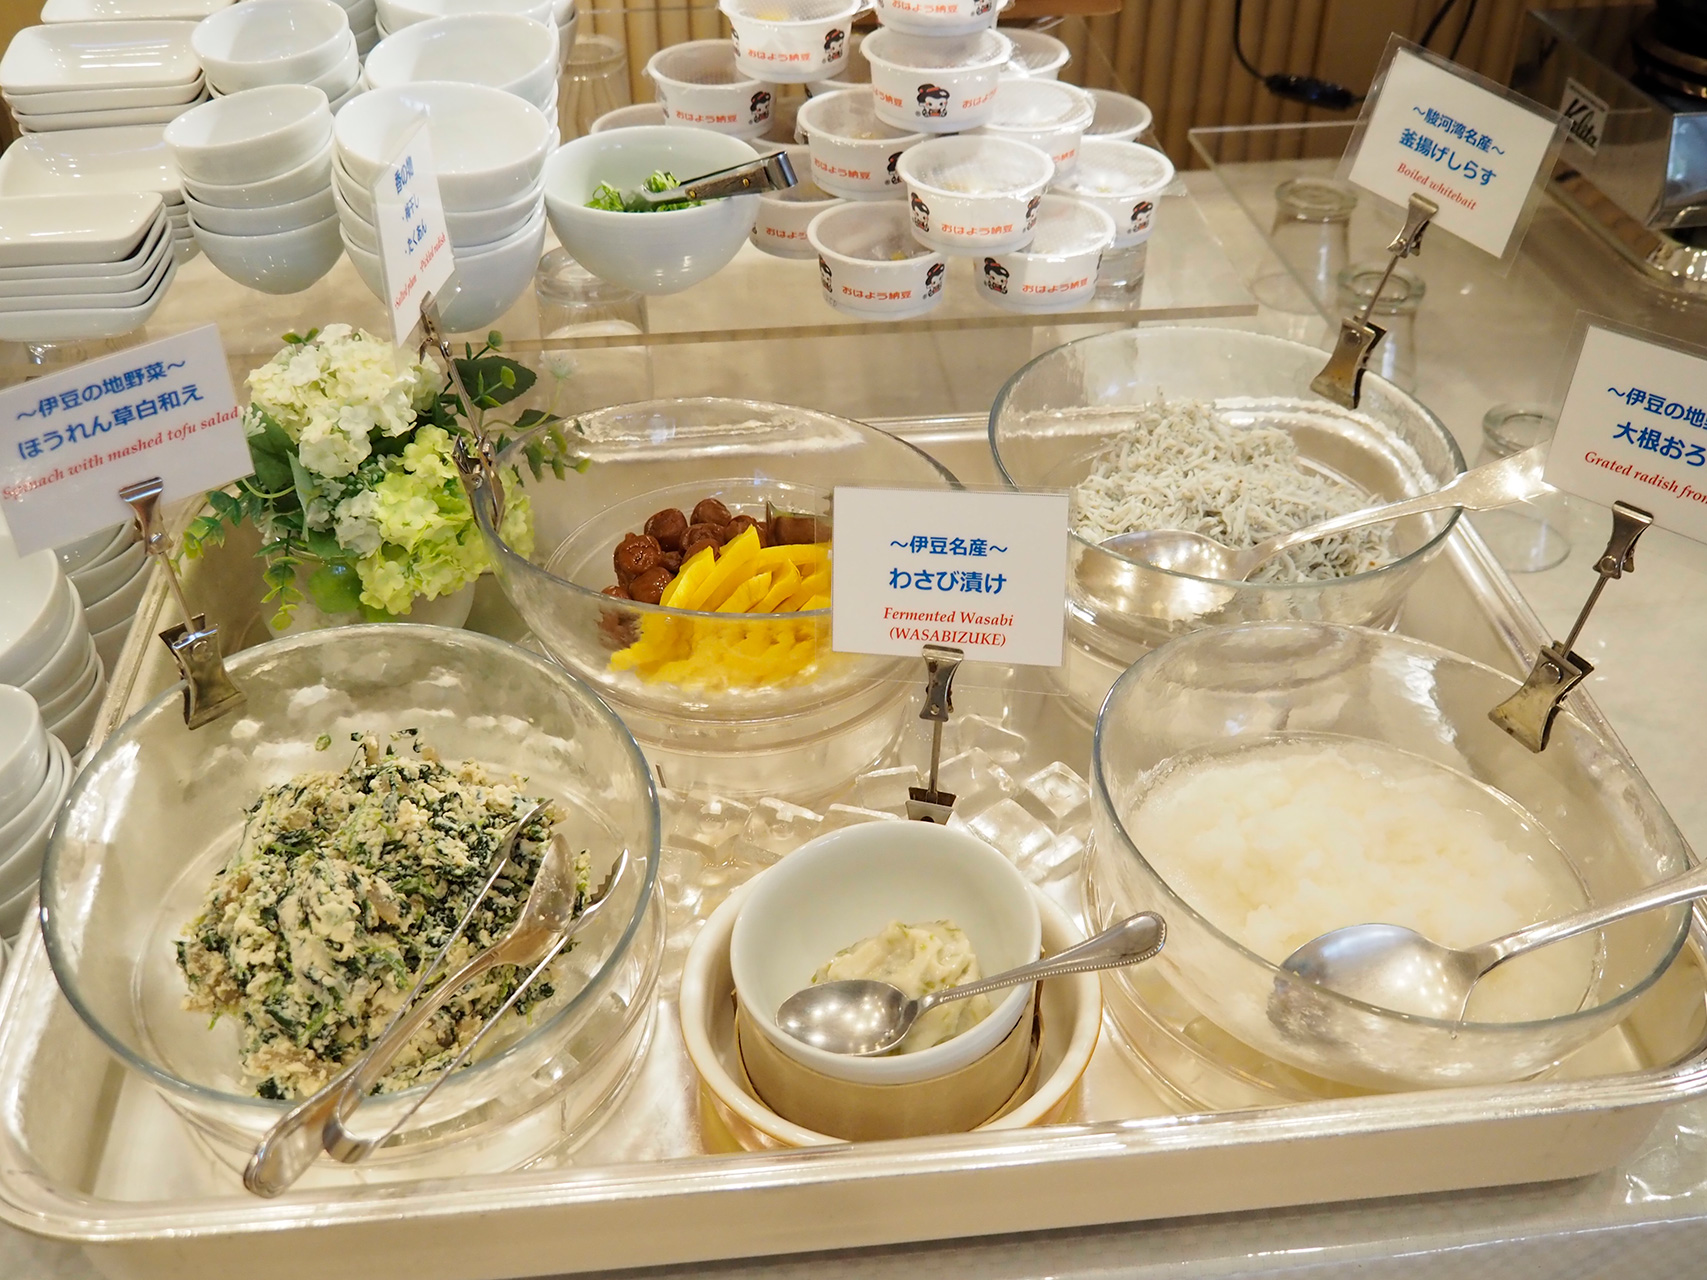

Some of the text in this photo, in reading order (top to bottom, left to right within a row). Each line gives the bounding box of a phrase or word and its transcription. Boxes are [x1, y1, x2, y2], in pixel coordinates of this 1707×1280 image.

[748, 49, 810, 62] おはよう納豆
[676, 110, 737, 123] おはよう納豆
[1399, 127, 1497, 186] 釜揚げしらす
[814, 158, 871, 181] おはよう納豆
[1397, 162, 1477, 210] Boiled whitebait
[941, 223, 1014, 236] おはよう納豆
[842, 286, 912, 300] おはよう納豆
[1022, 277, 1089, 294] おはよう納豆
[1607, 387, 1707, 430] ～伊豆の地
[18, 384, 204, 460] ほうれん草白和え
[68, 455, 104, 477] with
[108, 432, 163, 462] mashed
[167, 422, 196, 443] tofu
[200, 406, 240, 430] salad
[1584, 451, 1634, 477] Grated
[1634, 470, 1679, 493] radish
[889, 567, 1007, 594] わさび漬け
[883, 607, 1014, 627] Fermented Wasabi
[889, 626, 1007, 647] (WASABIZUKE)
